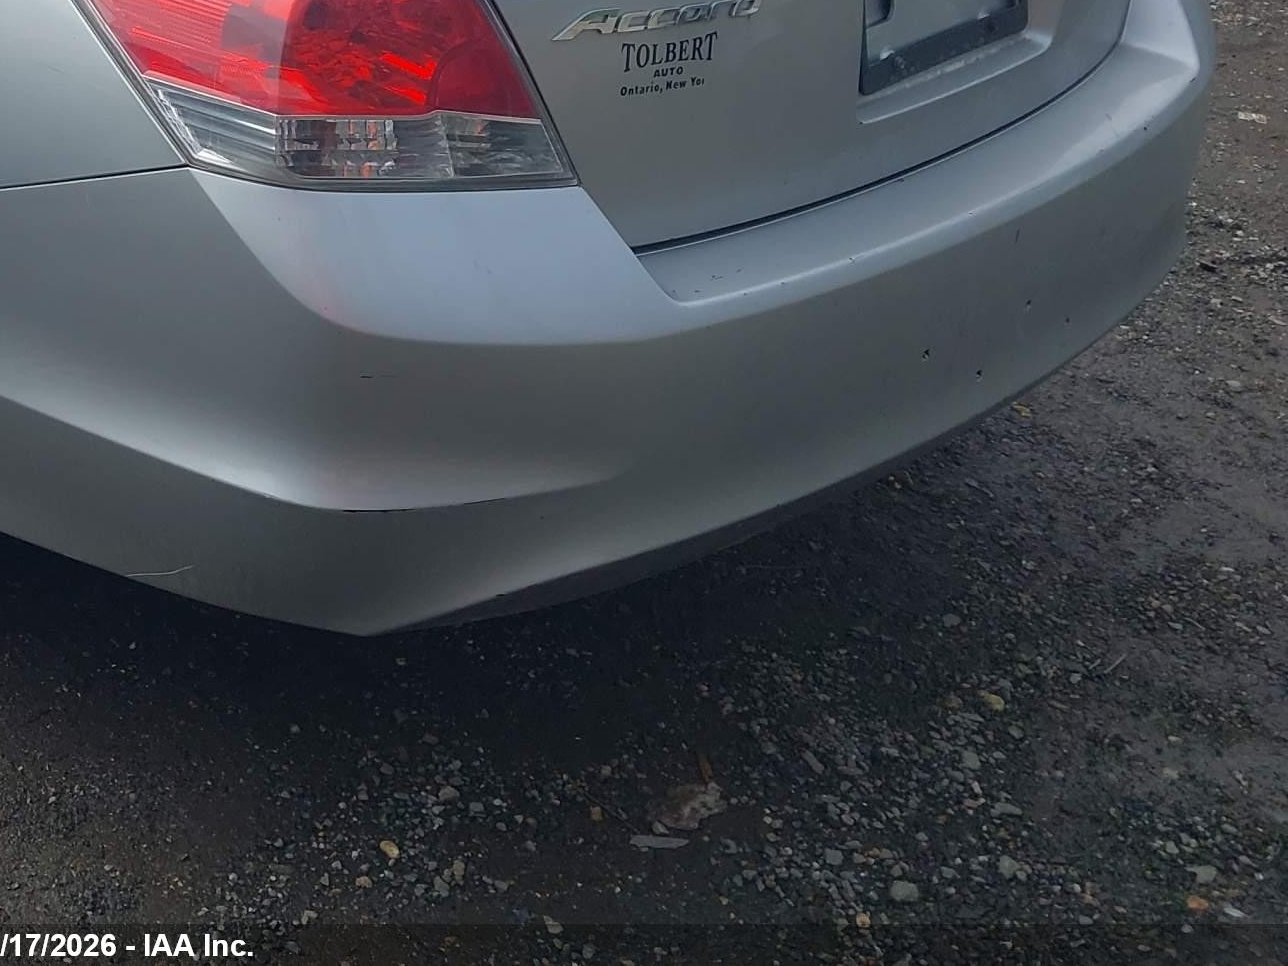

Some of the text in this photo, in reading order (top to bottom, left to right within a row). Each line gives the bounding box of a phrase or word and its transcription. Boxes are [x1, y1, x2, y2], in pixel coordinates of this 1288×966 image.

[621, 31, 718, 72] TOLBERT
[653, 66, 684, 78] AUTO
[620, 81, 663, 96] Ontario,
[666, 80, 687, 90] New
